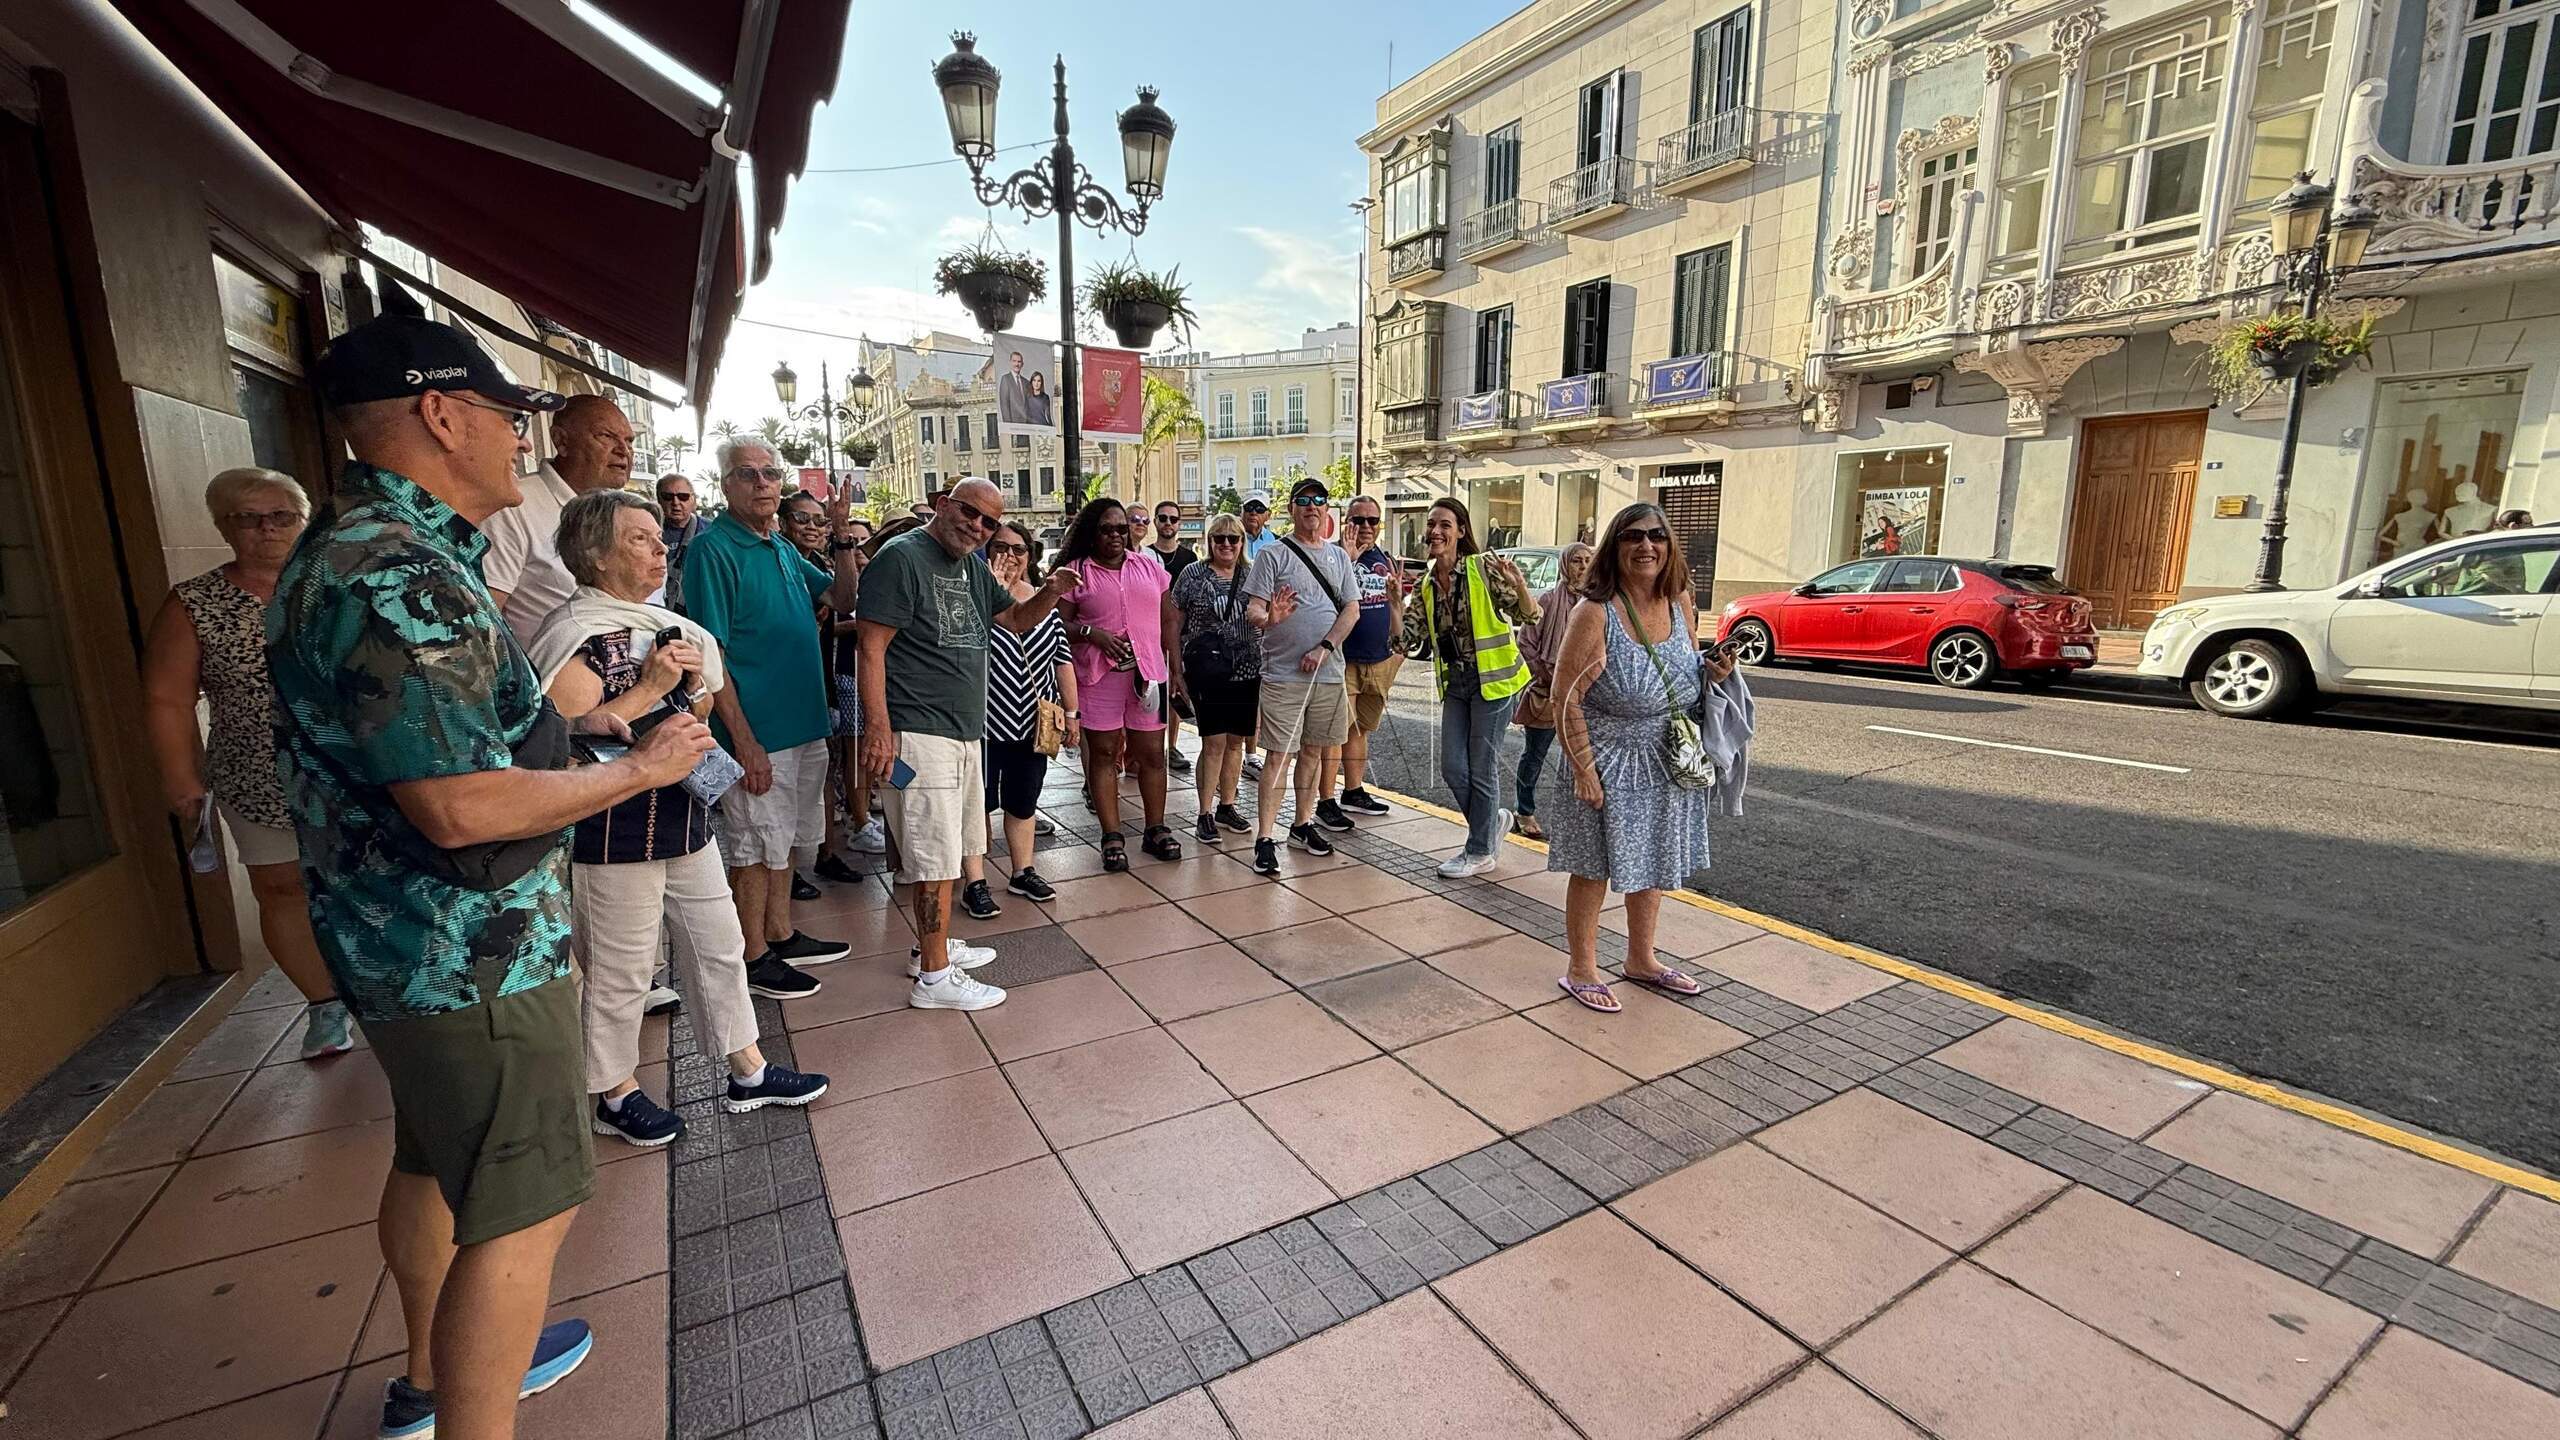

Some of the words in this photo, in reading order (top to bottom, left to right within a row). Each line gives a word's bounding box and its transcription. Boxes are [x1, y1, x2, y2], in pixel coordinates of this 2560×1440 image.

[424, 366, 468, 380] viaplay
[1002, 478, 1014, 489] 52
[1649, 476, 1681, 488] BIMBA
[1681, 475, 1690, 486] Y
[1689, 474, 1716, 486] LOLA
[1866, 492, 1894, 501] BIMBA
[1904, 490, 1928, 499] LOLA
